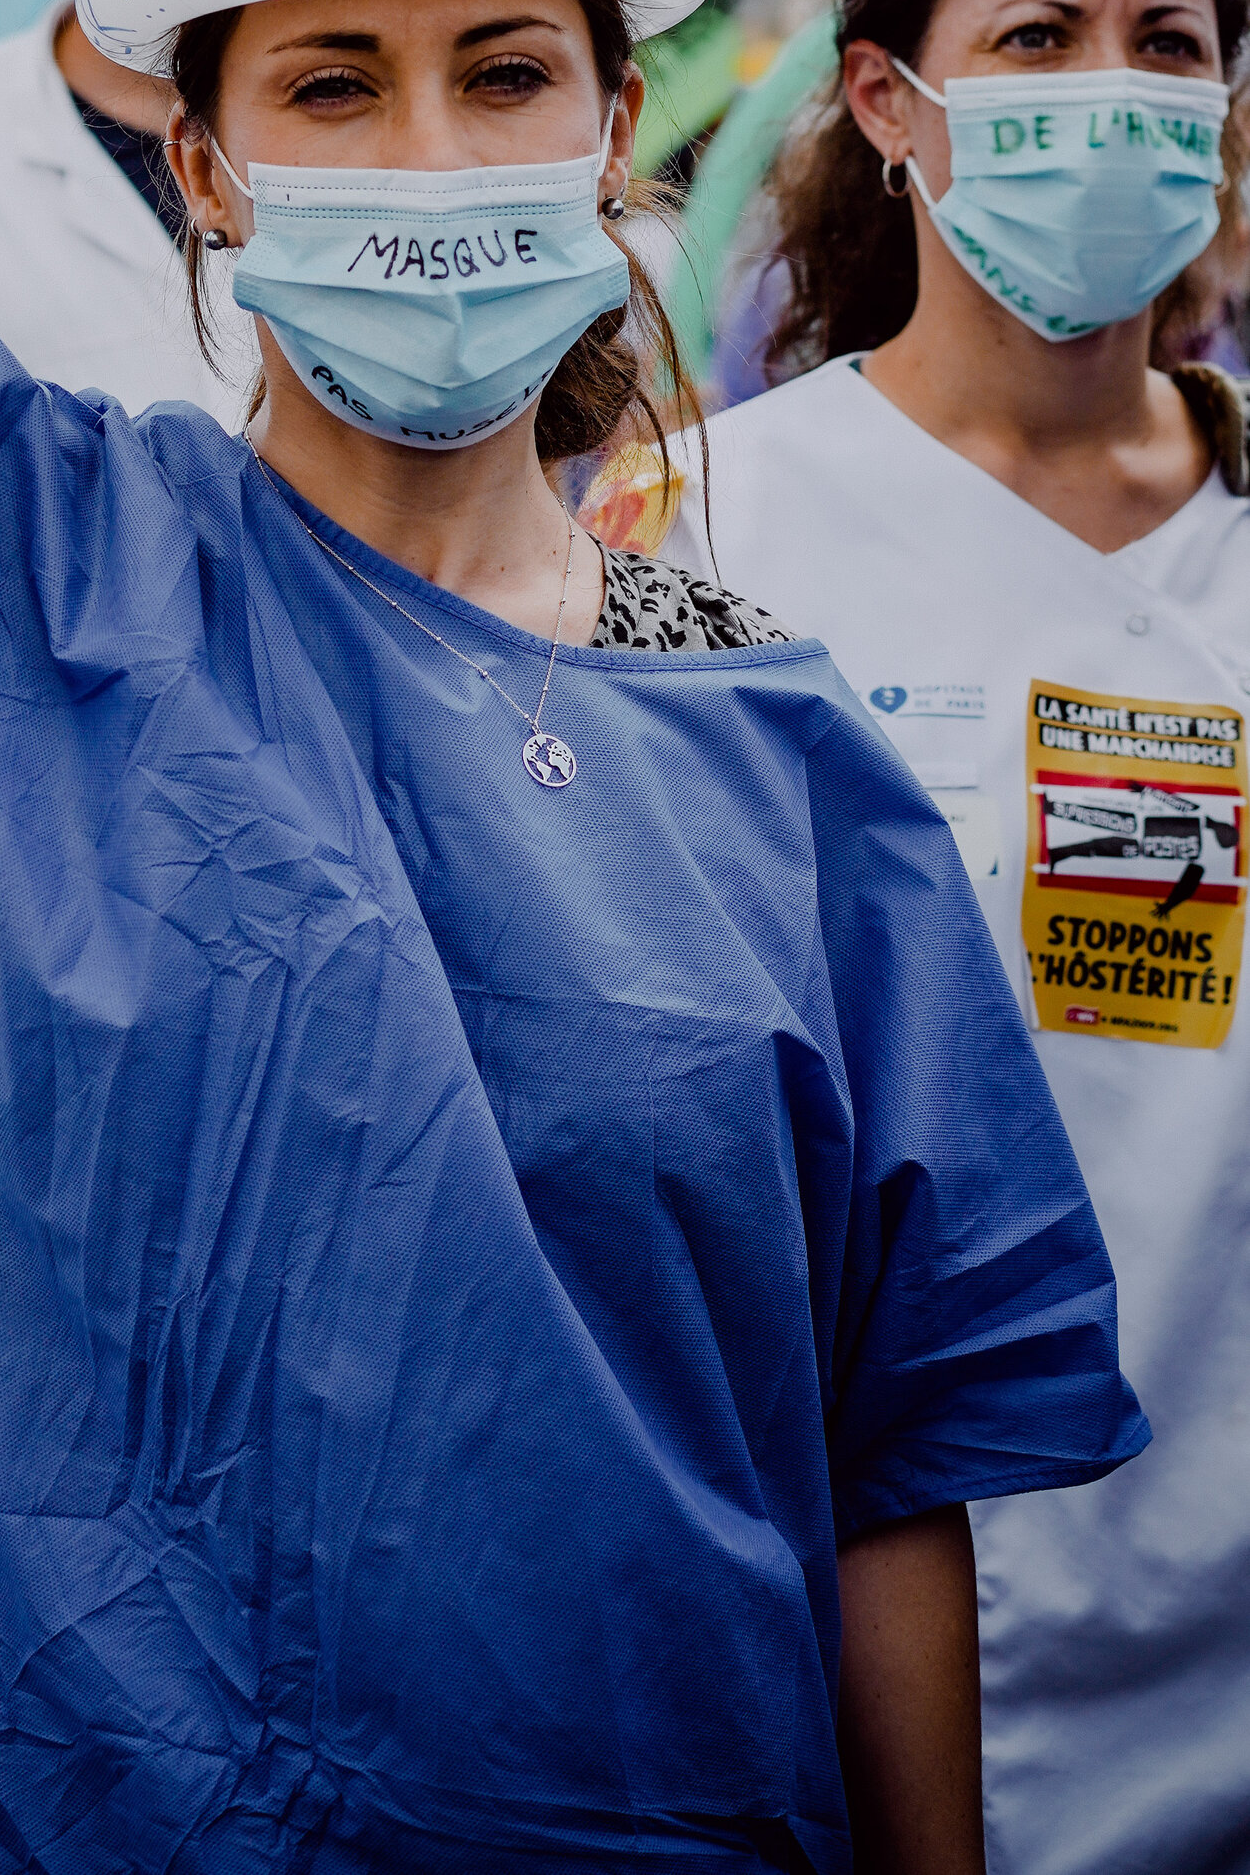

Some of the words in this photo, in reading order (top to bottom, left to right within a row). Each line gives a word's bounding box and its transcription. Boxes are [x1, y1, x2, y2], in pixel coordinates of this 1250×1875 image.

[988, 114, 1054, 156] DE
[347, 228, 538, 279] MASQUE
[311, 365, 374, 421] PAS
[1037, 696, 1062, 721] LA
[1065, 702, 1131, 732] SANTÉ
[1134, 713, 1192, 737] N'EST
[1195, 717, 1238, 741] PAS
[1041, 726, 1085, 751] UNE
[1087, 733, 1234, 768] MARCHANDISE
[1047, 915, 1213, 963] STOPPONS
